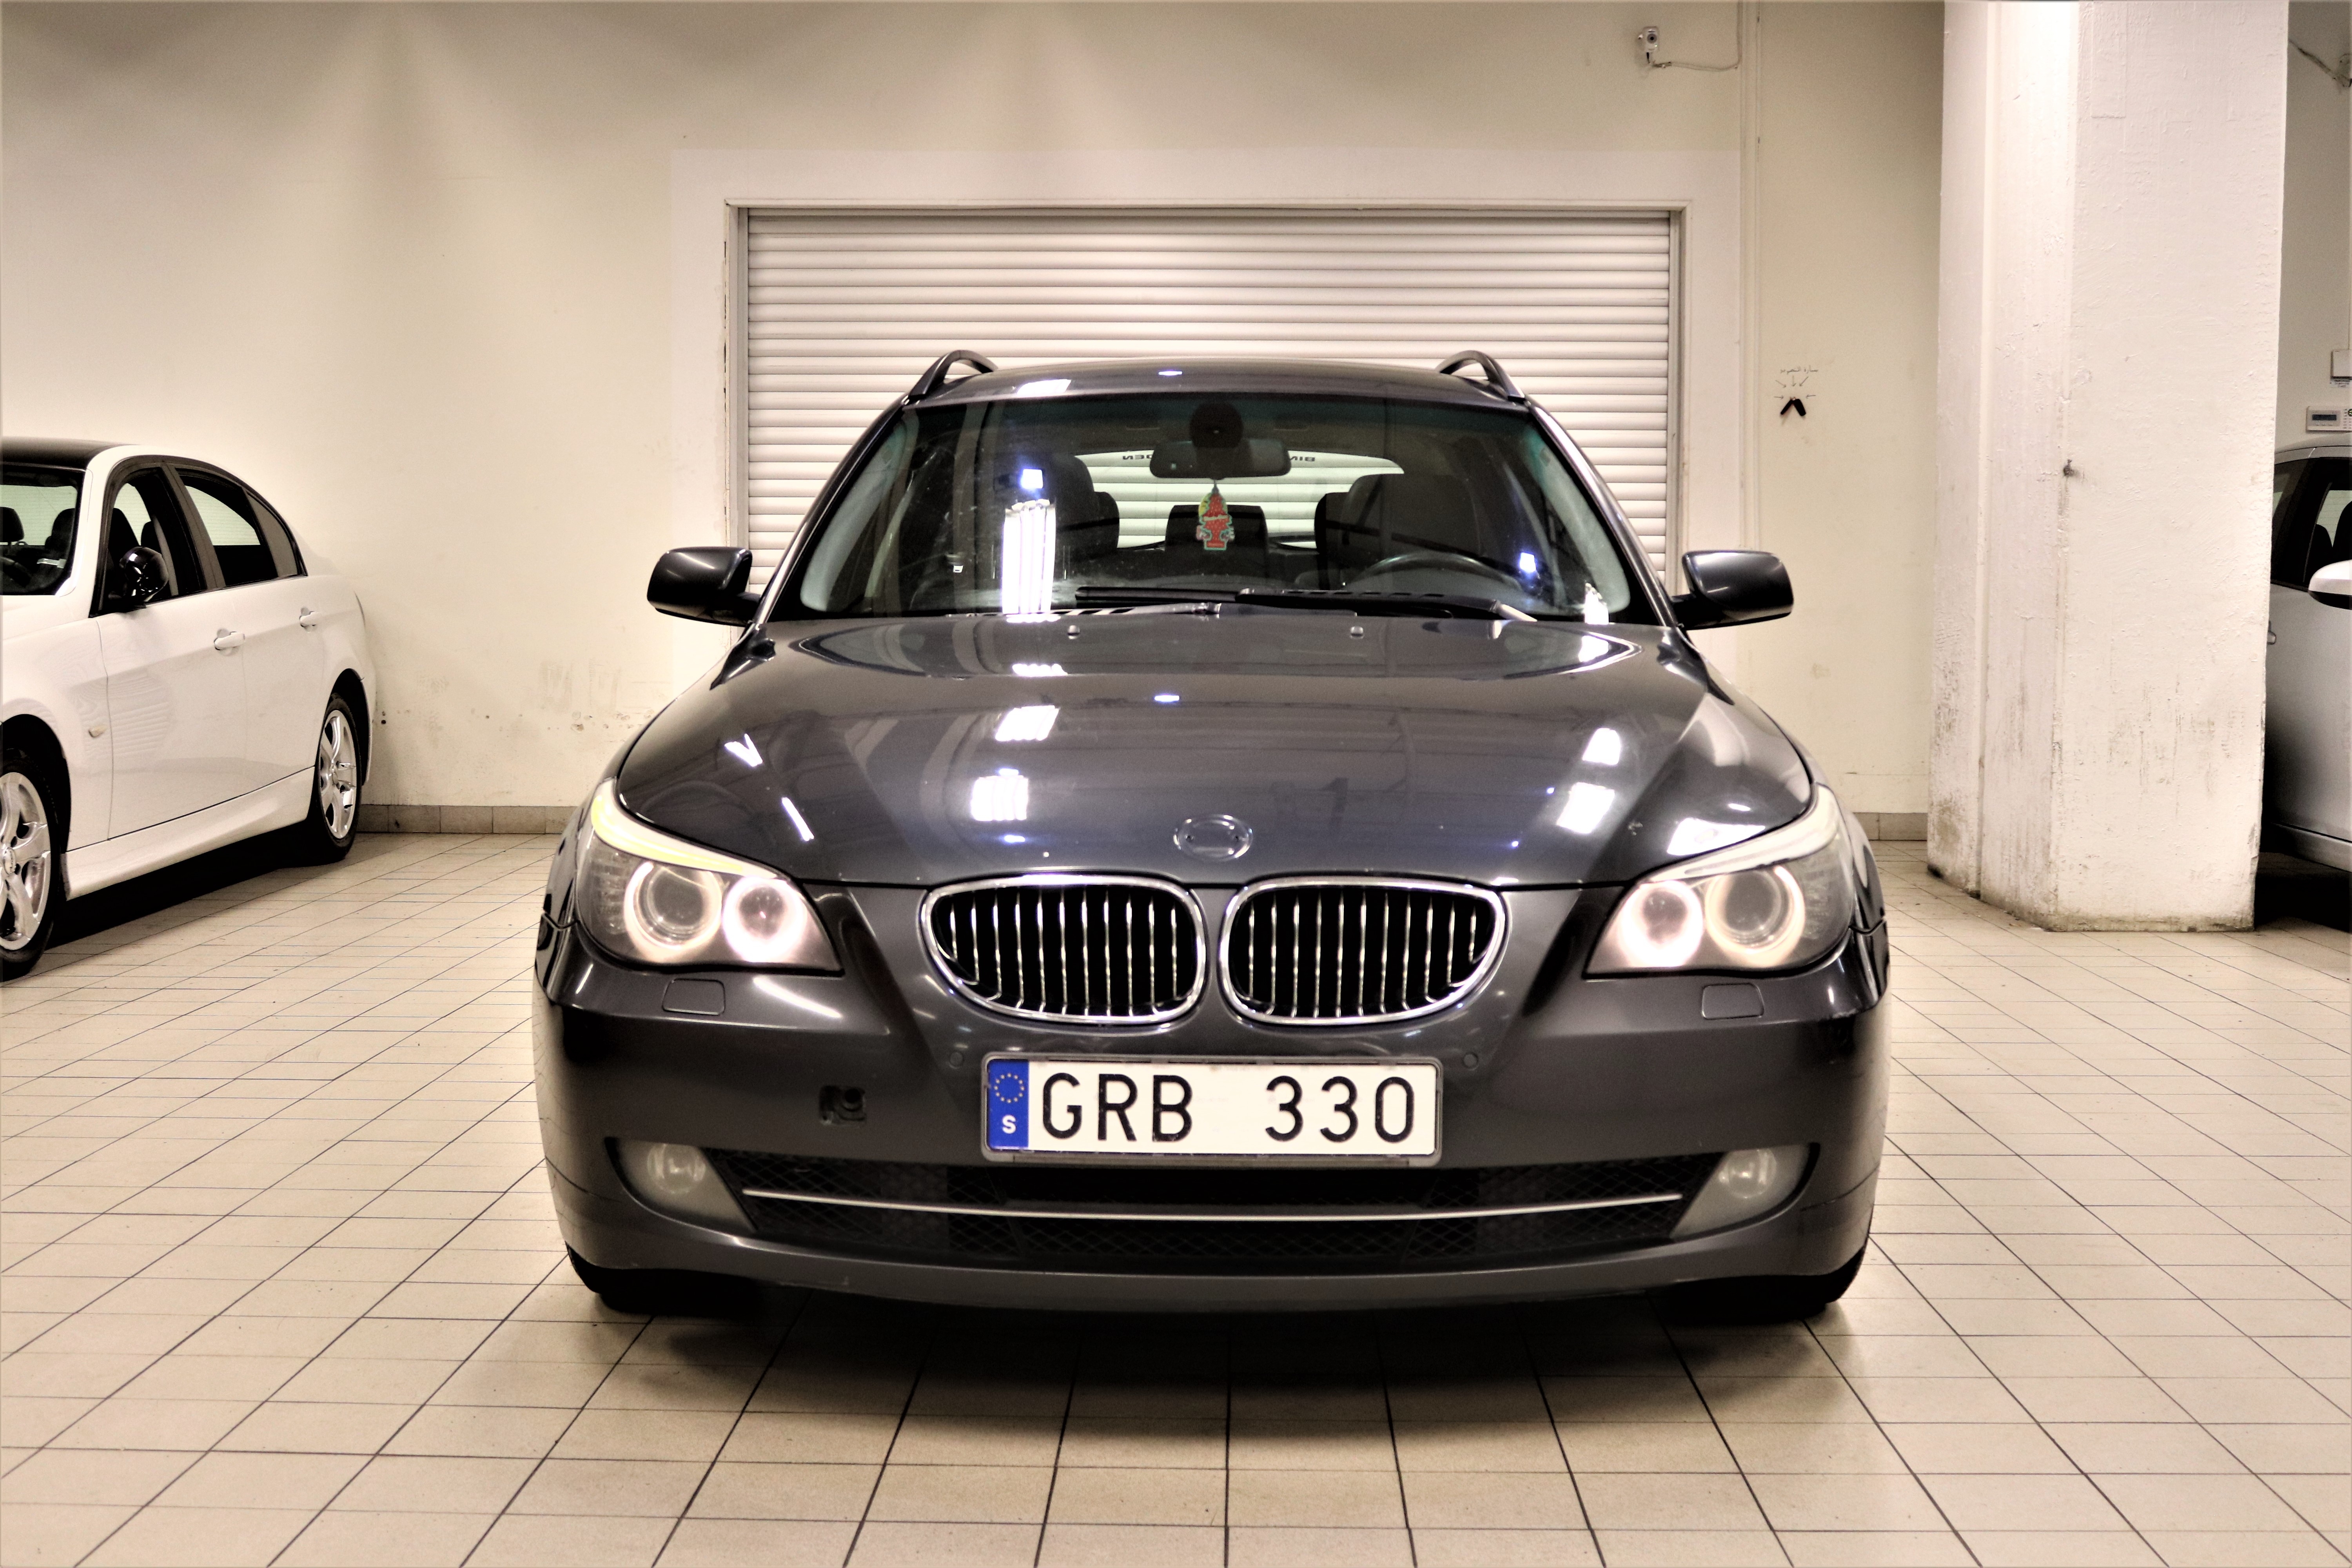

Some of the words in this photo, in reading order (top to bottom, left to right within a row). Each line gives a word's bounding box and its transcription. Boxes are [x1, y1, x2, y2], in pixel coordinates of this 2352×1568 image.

[1002, 1114, 1016, 1134] S
[1043, 1073, 1192, 1142] GRB
[1266, 1076, 1414, 1143] 330
